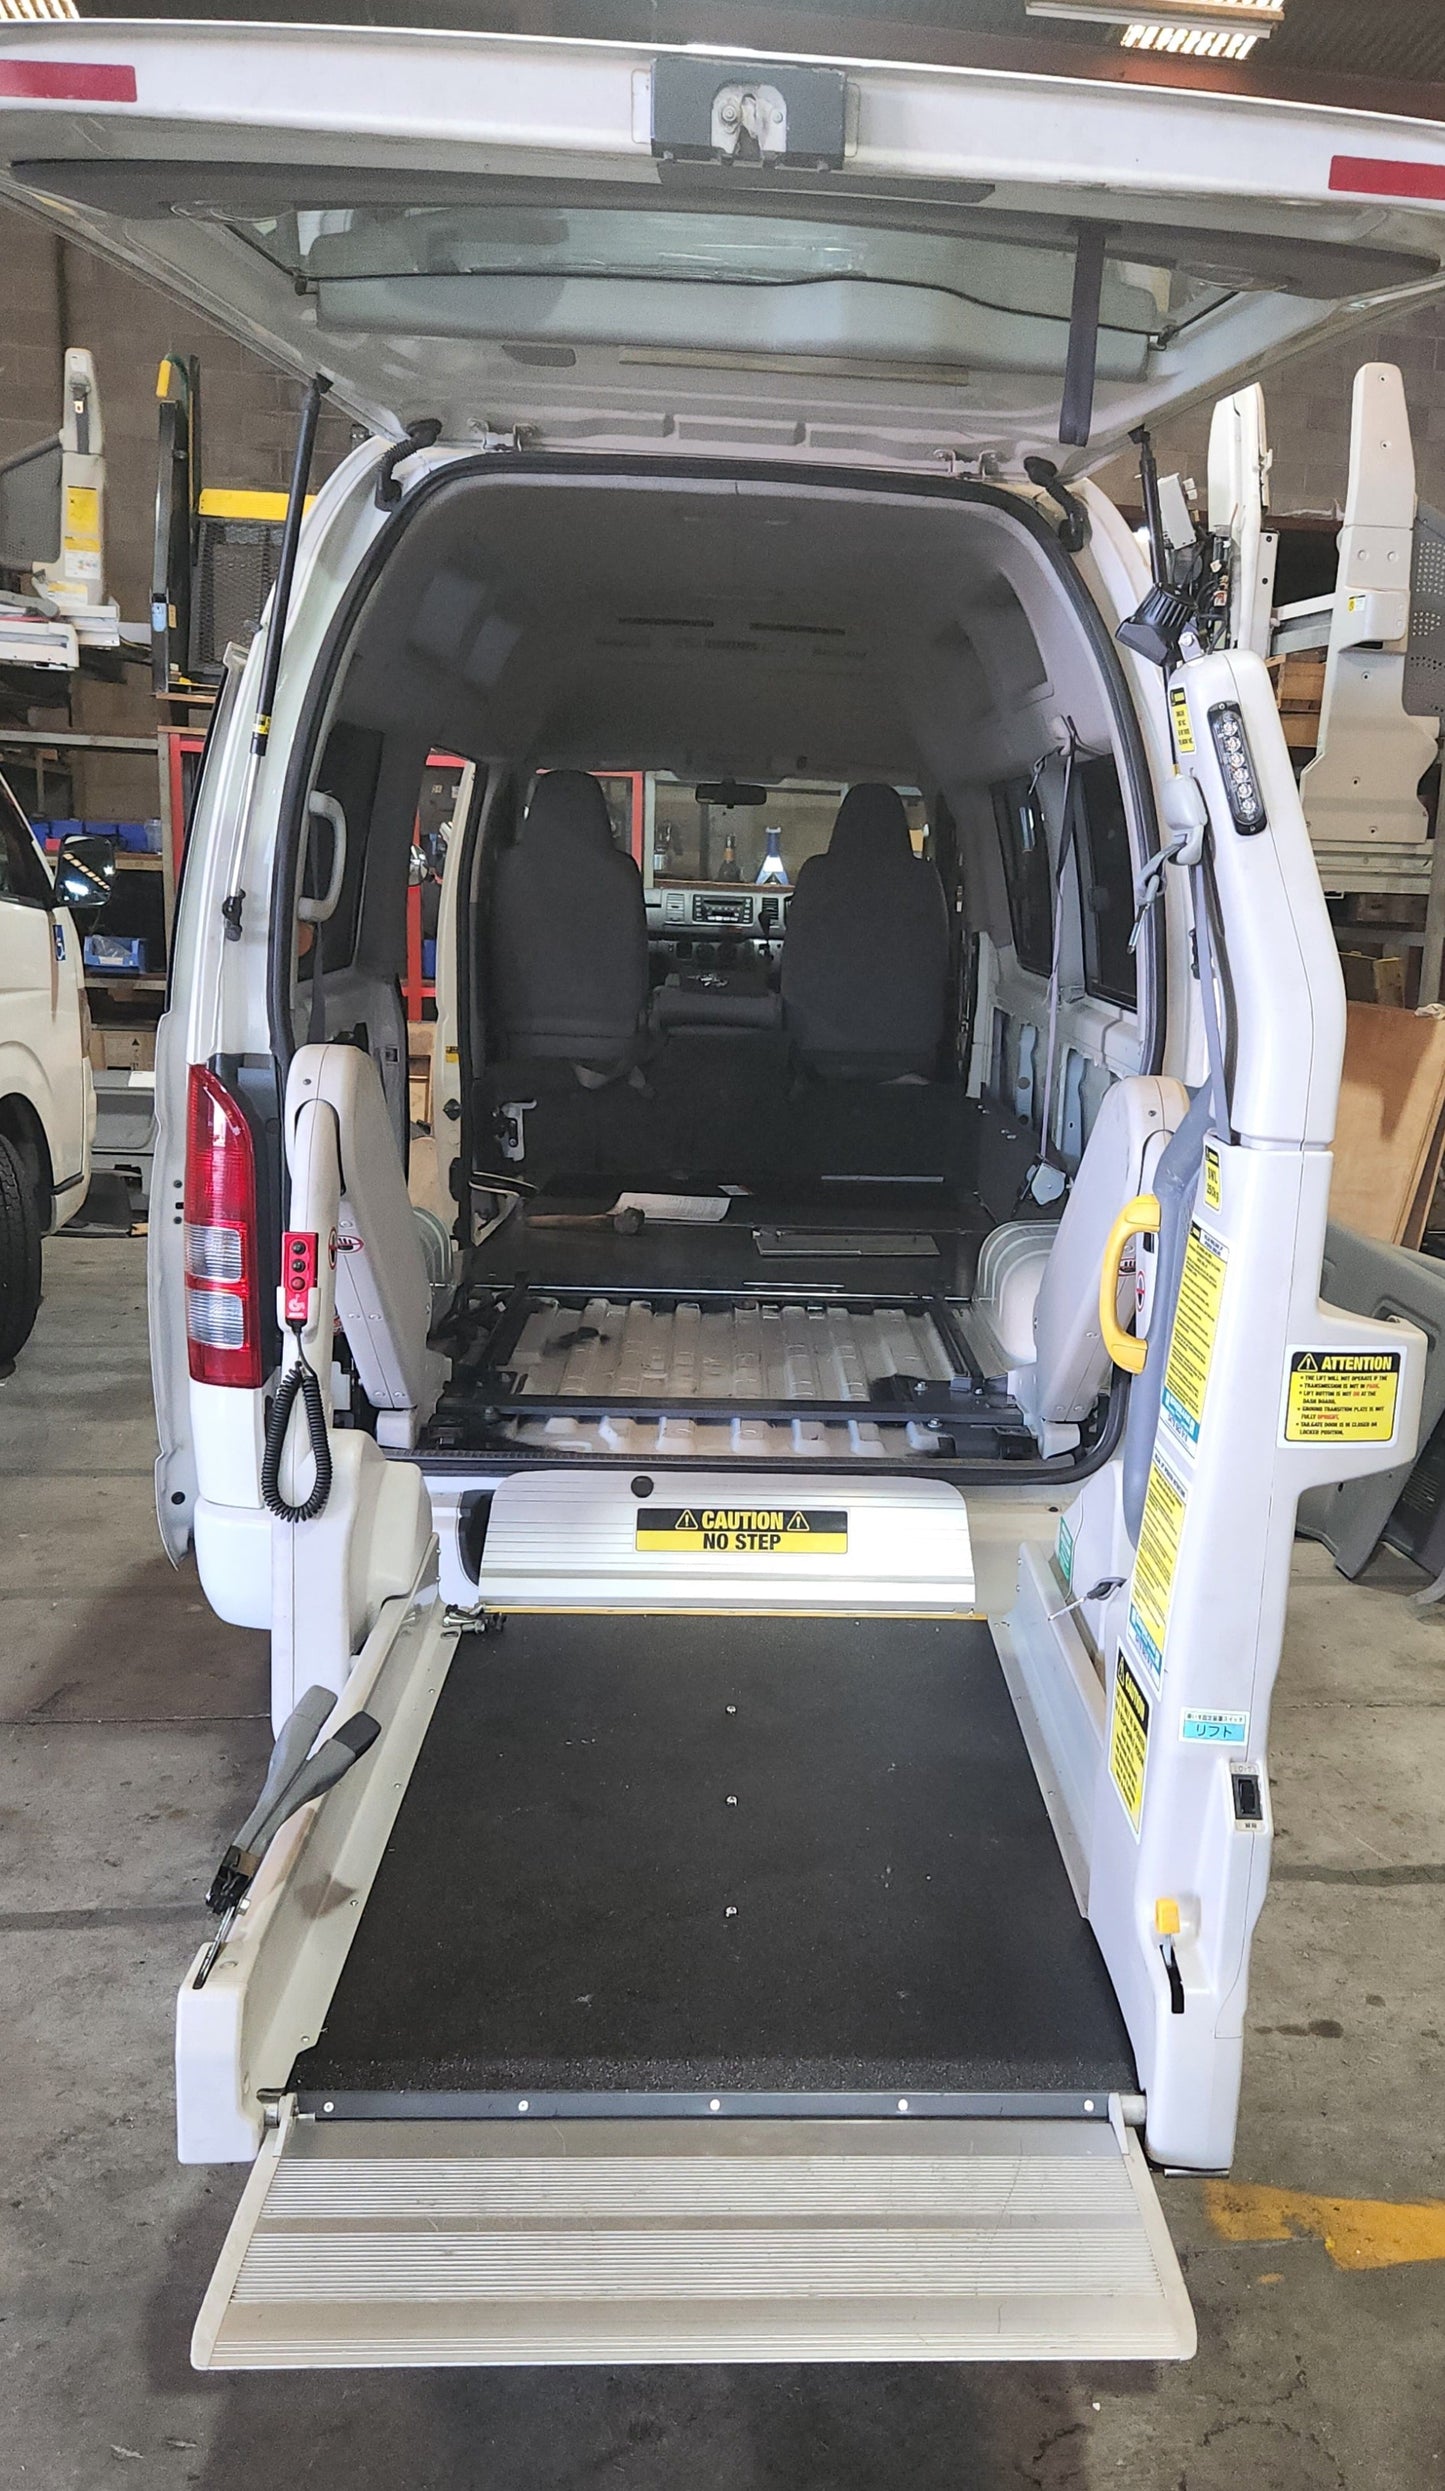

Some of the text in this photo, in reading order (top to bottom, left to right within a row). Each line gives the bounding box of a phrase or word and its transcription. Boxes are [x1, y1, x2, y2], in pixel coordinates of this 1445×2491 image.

[1321, 1356, 1392, 1371] ATTENTION
[701, 1511, 784, 1530] CAUTION
[703, 1533, 782, 1551] NO STEP
[1196, 1724, 1232, 1738] リフト
